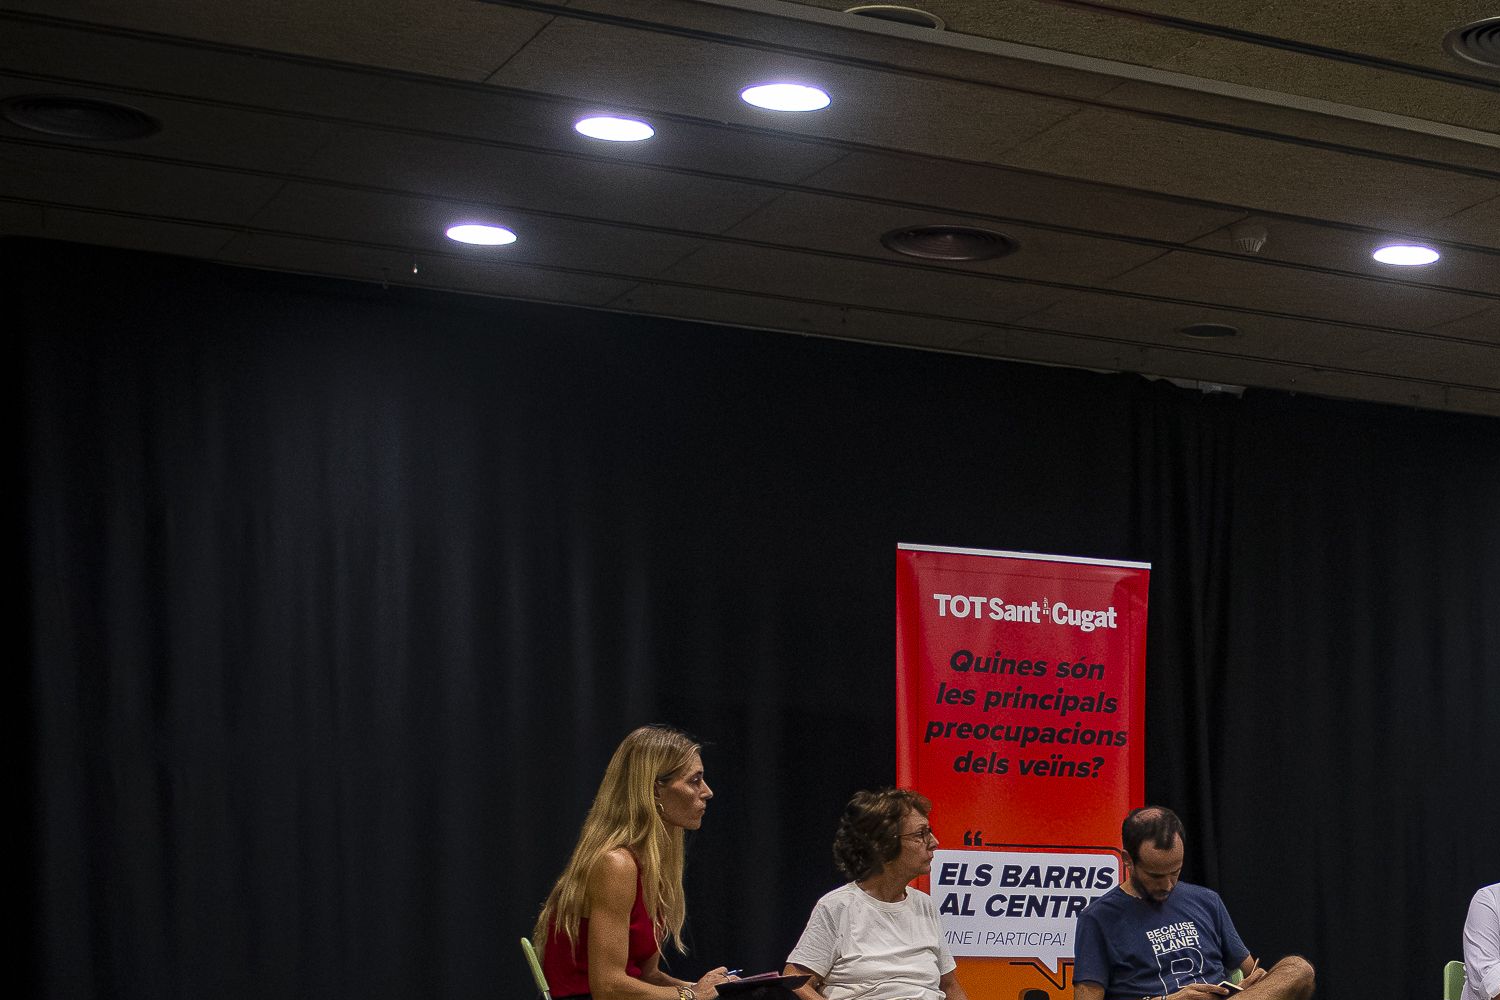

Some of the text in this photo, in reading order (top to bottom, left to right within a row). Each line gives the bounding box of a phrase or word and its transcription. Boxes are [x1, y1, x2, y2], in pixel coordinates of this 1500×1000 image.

[933, 593, 1118, 632] TOT Sant Cugat
[950, 650, 1105, 680] Quines són
[935, 682, 1118, 716] les principals
[924, 720, 1127, 748] preocupacions
[953, 751, 1105, 778] dels veïns?
[938, 862, 1115, 889] ELS BARRIS
[940, 893, 976, 916] AL
[977, 931, 982, 945] I
[985, 931, 1067, 946] PARTICIPA!
[1146, 921, 1195, 940] BECAUSE
[1150, 932, 1177, 945] THERE
[1187, 929, 1198, 937] NO
[1152, 935, 1200, 954] PLANET
